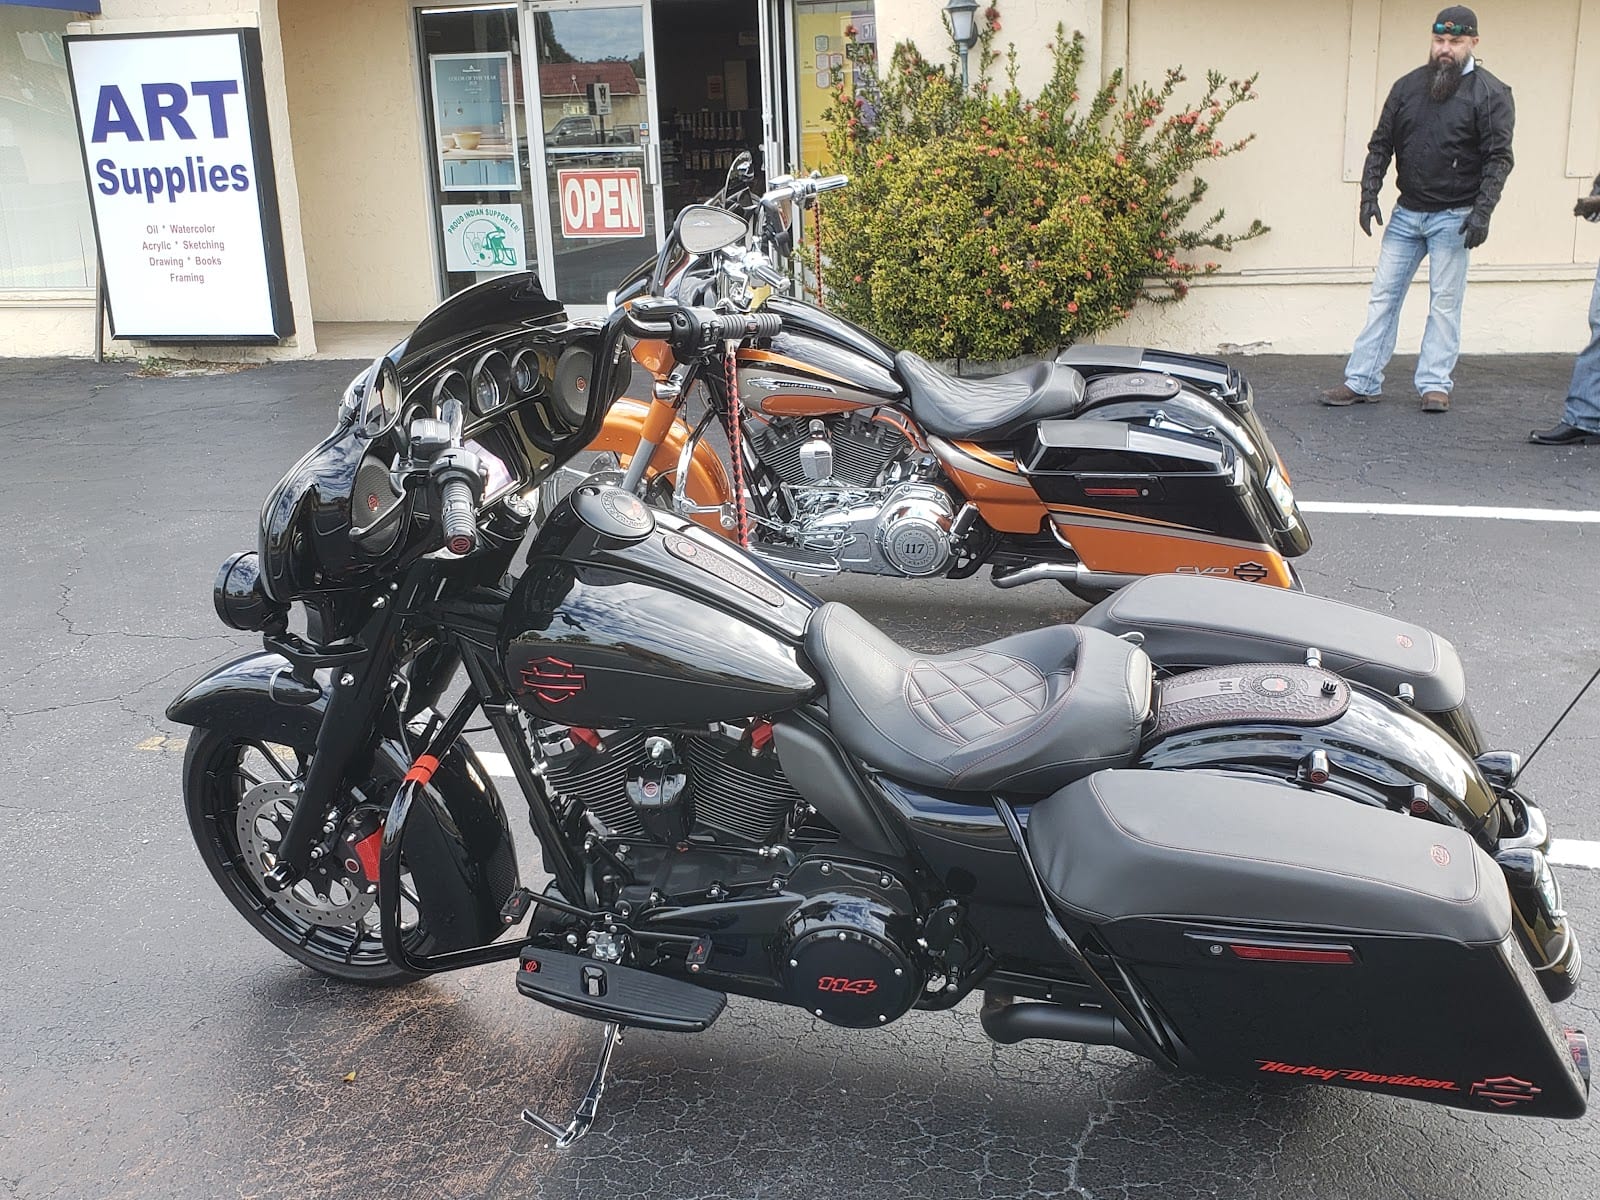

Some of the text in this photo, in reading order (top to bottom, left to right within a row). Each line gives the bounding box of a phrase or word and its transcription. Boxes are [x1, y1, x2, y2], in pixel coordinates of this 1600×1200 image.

[91, 79, 239, 143] ART
[95, 155, 250, 204] Supplies
[565, 178, 640, 229] OPEN
[447, 215, 465, 234] PROUD
[463, 208, 485, 219] INDIAN
[146, 223, 216, 235] Oil Watercolor
[142, 240, 225, 253] Acrylic Sketching
[149, 255, 222, 268] Drawing Books
[169, 272, 205, 284] Framing
[904, 543, 925, 554] 117
[1175, 566, 1230, 576] CVO
[818, 976, 878, 994] 114
[1255, 1059, 1461, 1092] Harley-Davidson
